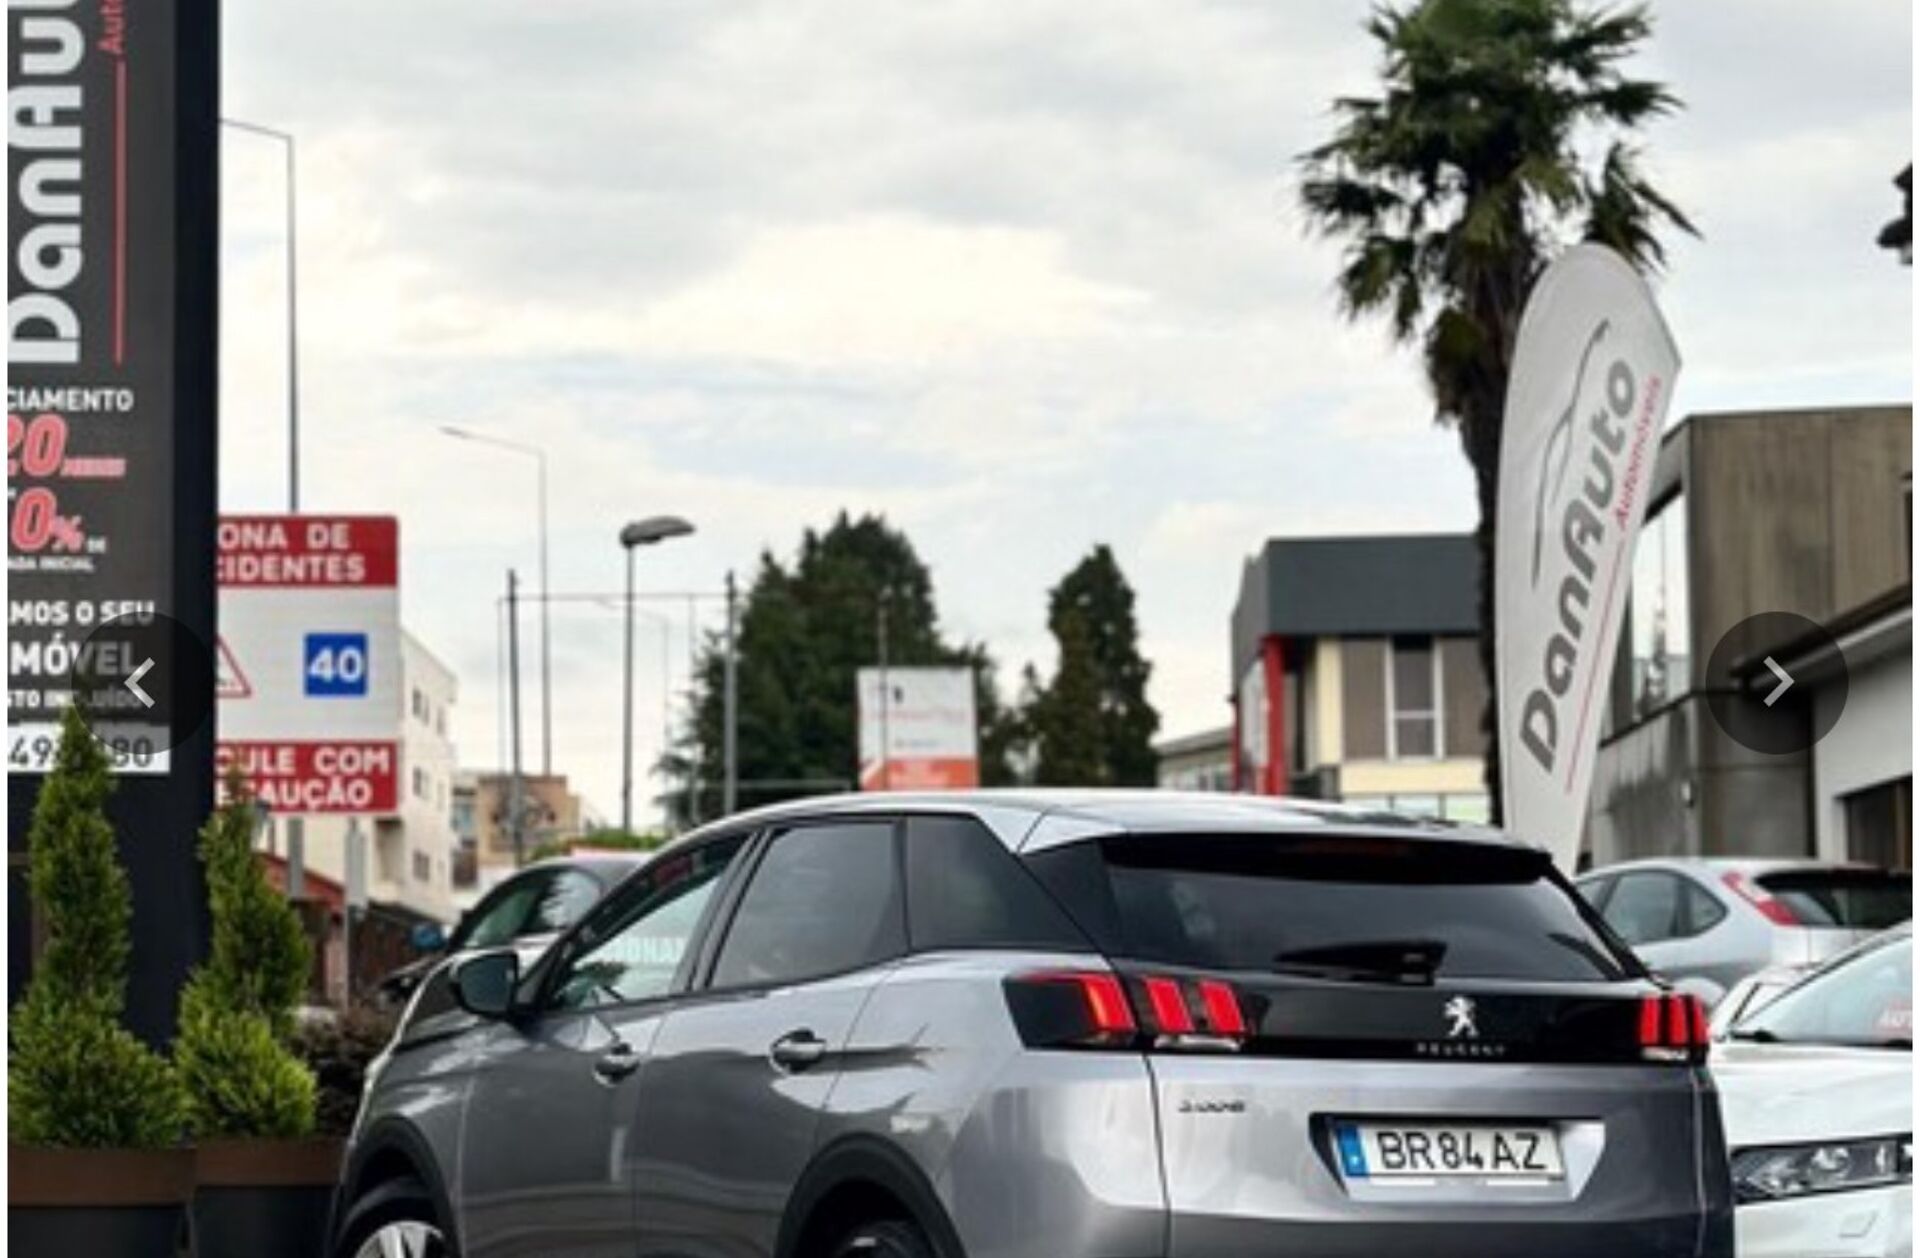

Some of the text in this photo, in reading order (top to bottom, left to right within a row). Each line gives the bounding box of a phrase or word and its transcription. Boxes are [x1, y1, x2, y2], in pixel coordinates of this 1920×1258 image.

[218, 523, 350, 550] ONA DE
[217, 554, 365, 582] IDENTES
[1520, 358, 1635, 774] DanAuto
[75, 600, 95, 627] O
[100, 600, 155, 626] SEU
[10, 631, 137, 676] MÓVEL
[309, 647, 363, 683] 40
[313, 746, 390, 775] COM
[1376, 1130, 1548, 1171] BR 84 AZ
